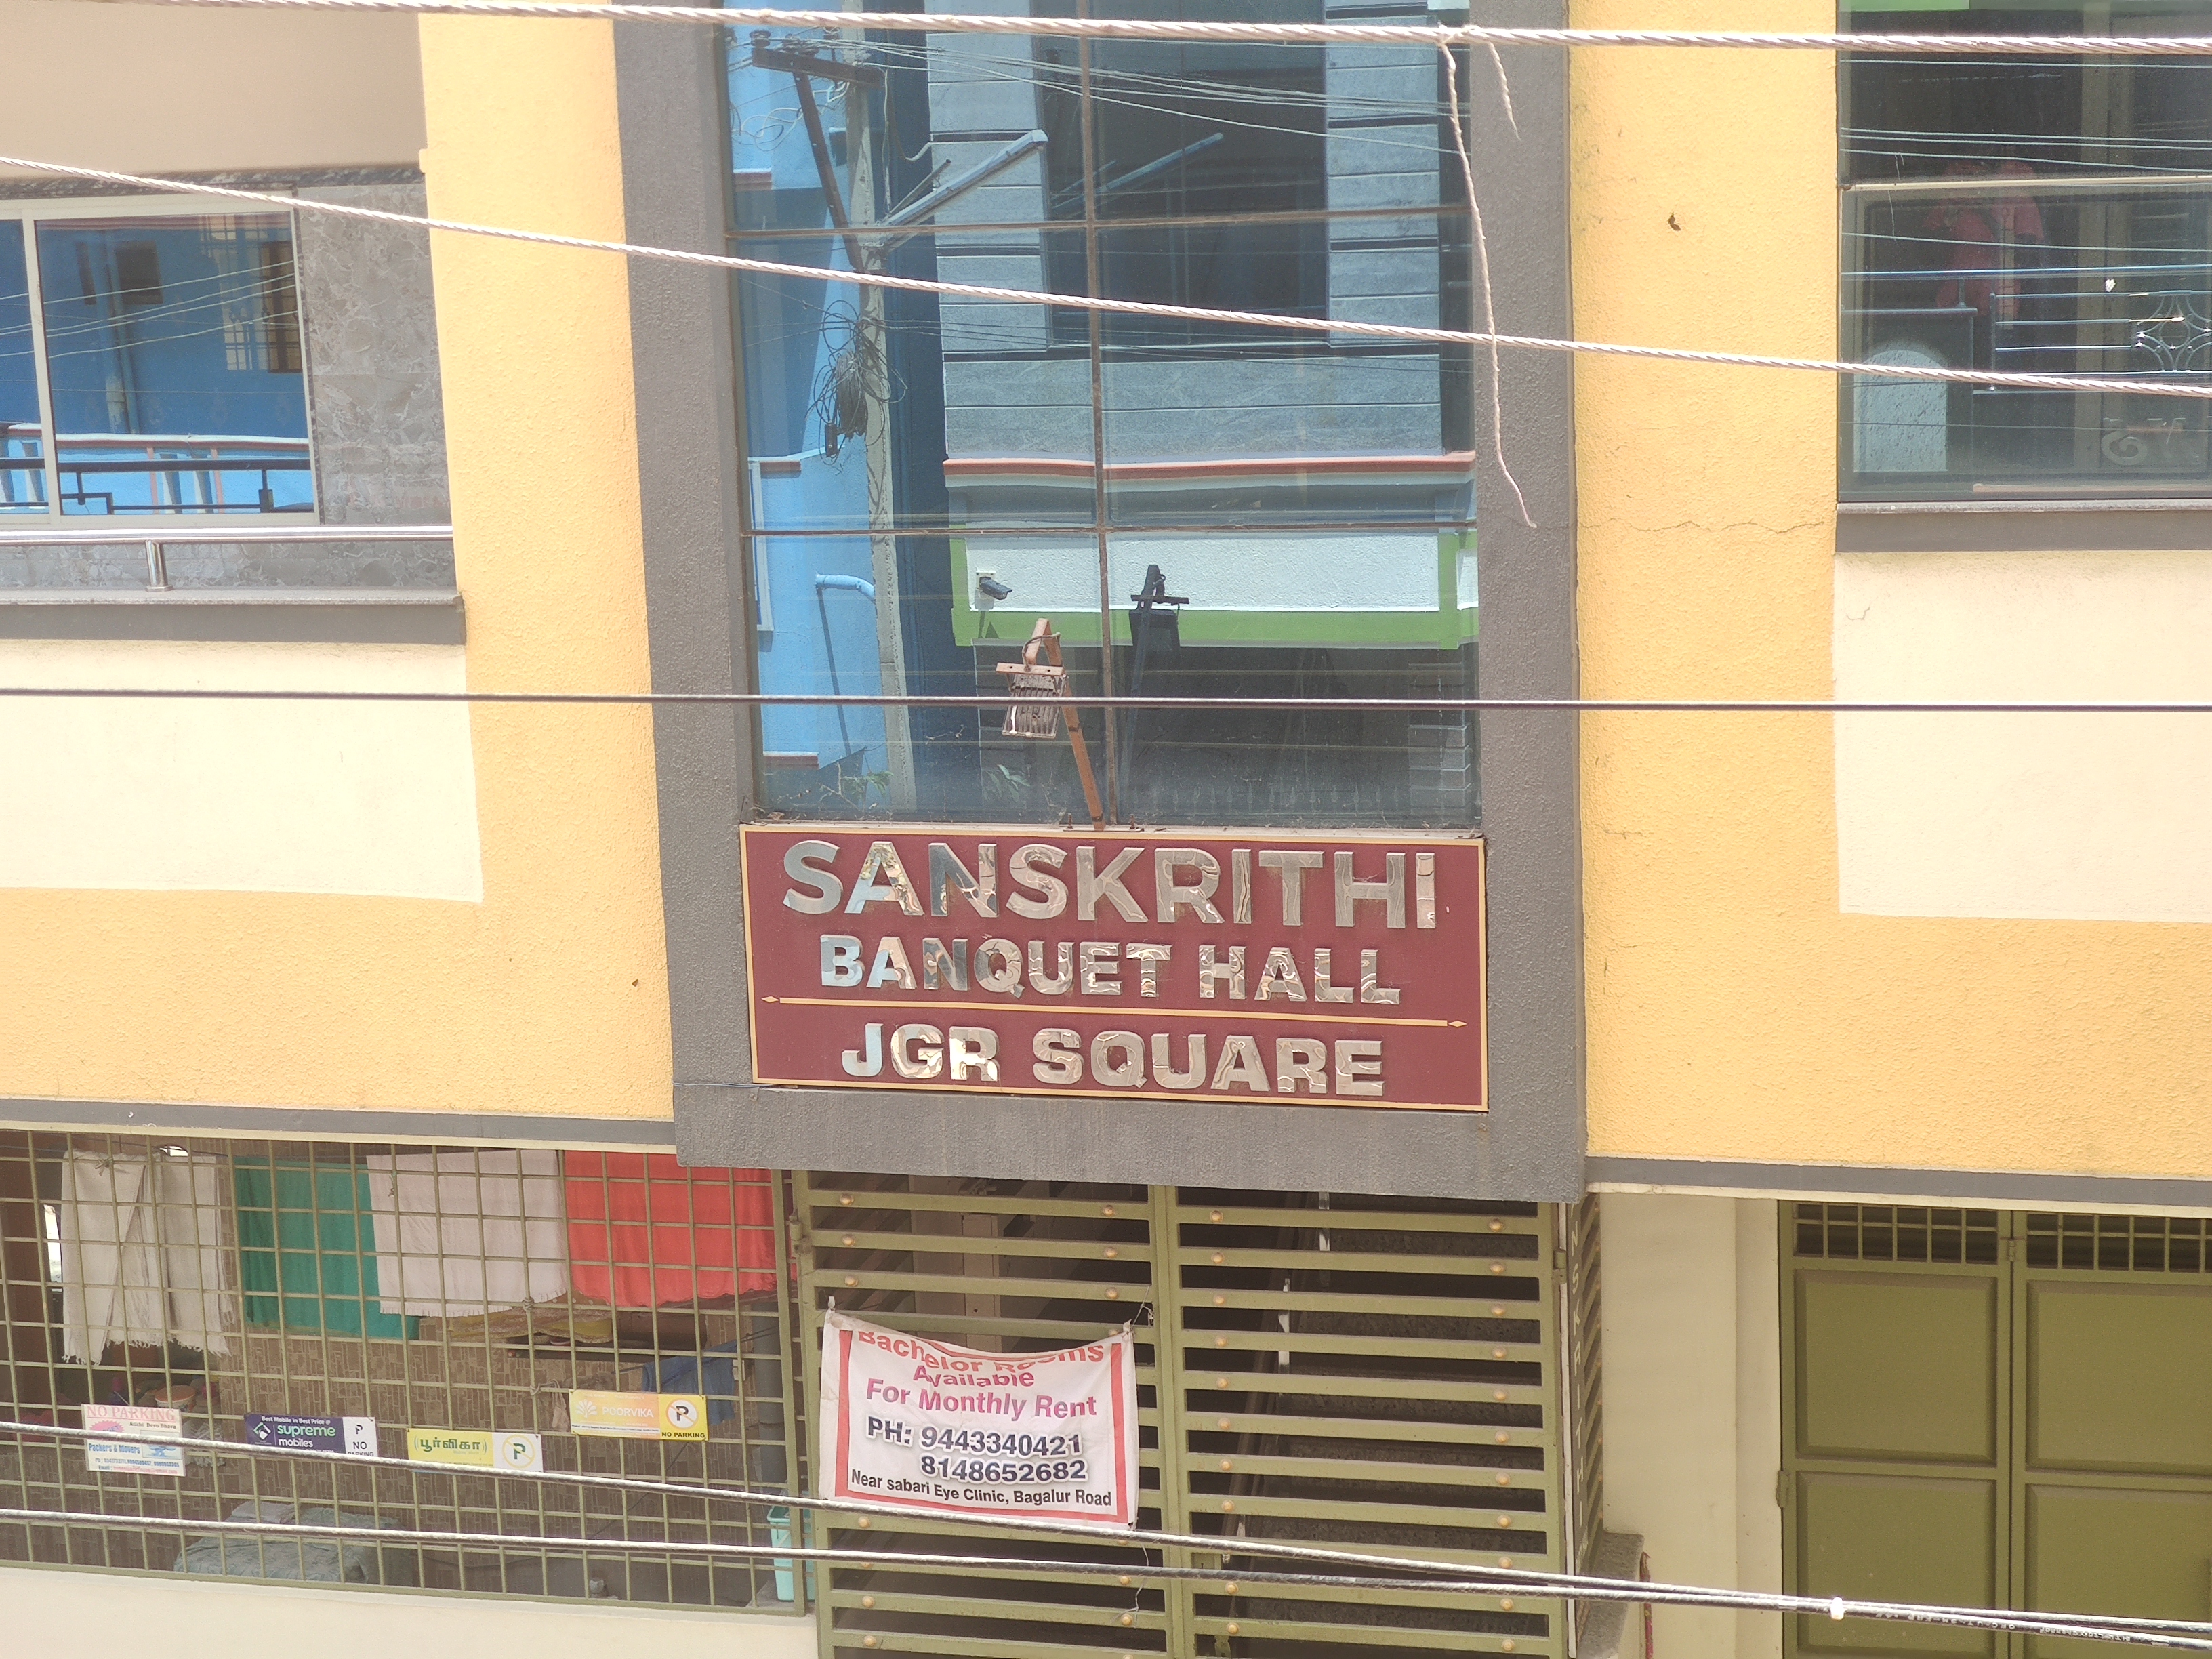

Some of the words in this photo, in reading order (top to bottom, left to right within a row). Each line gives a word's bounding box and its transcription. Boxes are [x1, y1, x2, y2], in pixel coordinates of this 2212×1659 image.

[782, 840, 1436, 929] SANSKRITHI
[819, 934, 1171, 998] BANQUET
[1198, 943, 1401, 1004] HALL
[841, 1021, 998, 1082] JGR
[1031, 1027, 1385, 1097] SQUARE
[858, 1331, 983, 1372] Bachelor
[913, 1365, 1035, 1387] Available
[87, 1405, 108, 1417] NO
[112, 1406, 176, 1421] PARKING
[602, 1406, 654, 1418] POORVIKA
[867, 1378, 911, 1406] For
[919, 1387, 1027, 1421] Monthly
[1035, 1395, 1097, 1419] Rent
[277, 1425, 336, 1437] supreme
[278, 1438, 314, 1448] mobiles
[867, 1416, 912, 1445] PH:
[921, 1425, 1081, 1456] 9443340421
[89, 1443, 112, 1452] Packers
[119, 1445, 140, 1454] Movers
[353, 1441, 367, 1450] NO
[921, 1455, 1086, 1483] 8148652682
[851, 1469, 883, 1489] Near
[887, 1478, 930, 1496] sabari
[934, 1483, 960, 1501] Eye
[963, 1488, 1010, 1505] Clinic,
[1013, 1490, 1071, 1506] Bagalur
[1076, 1490, 1112, 1507] Road
